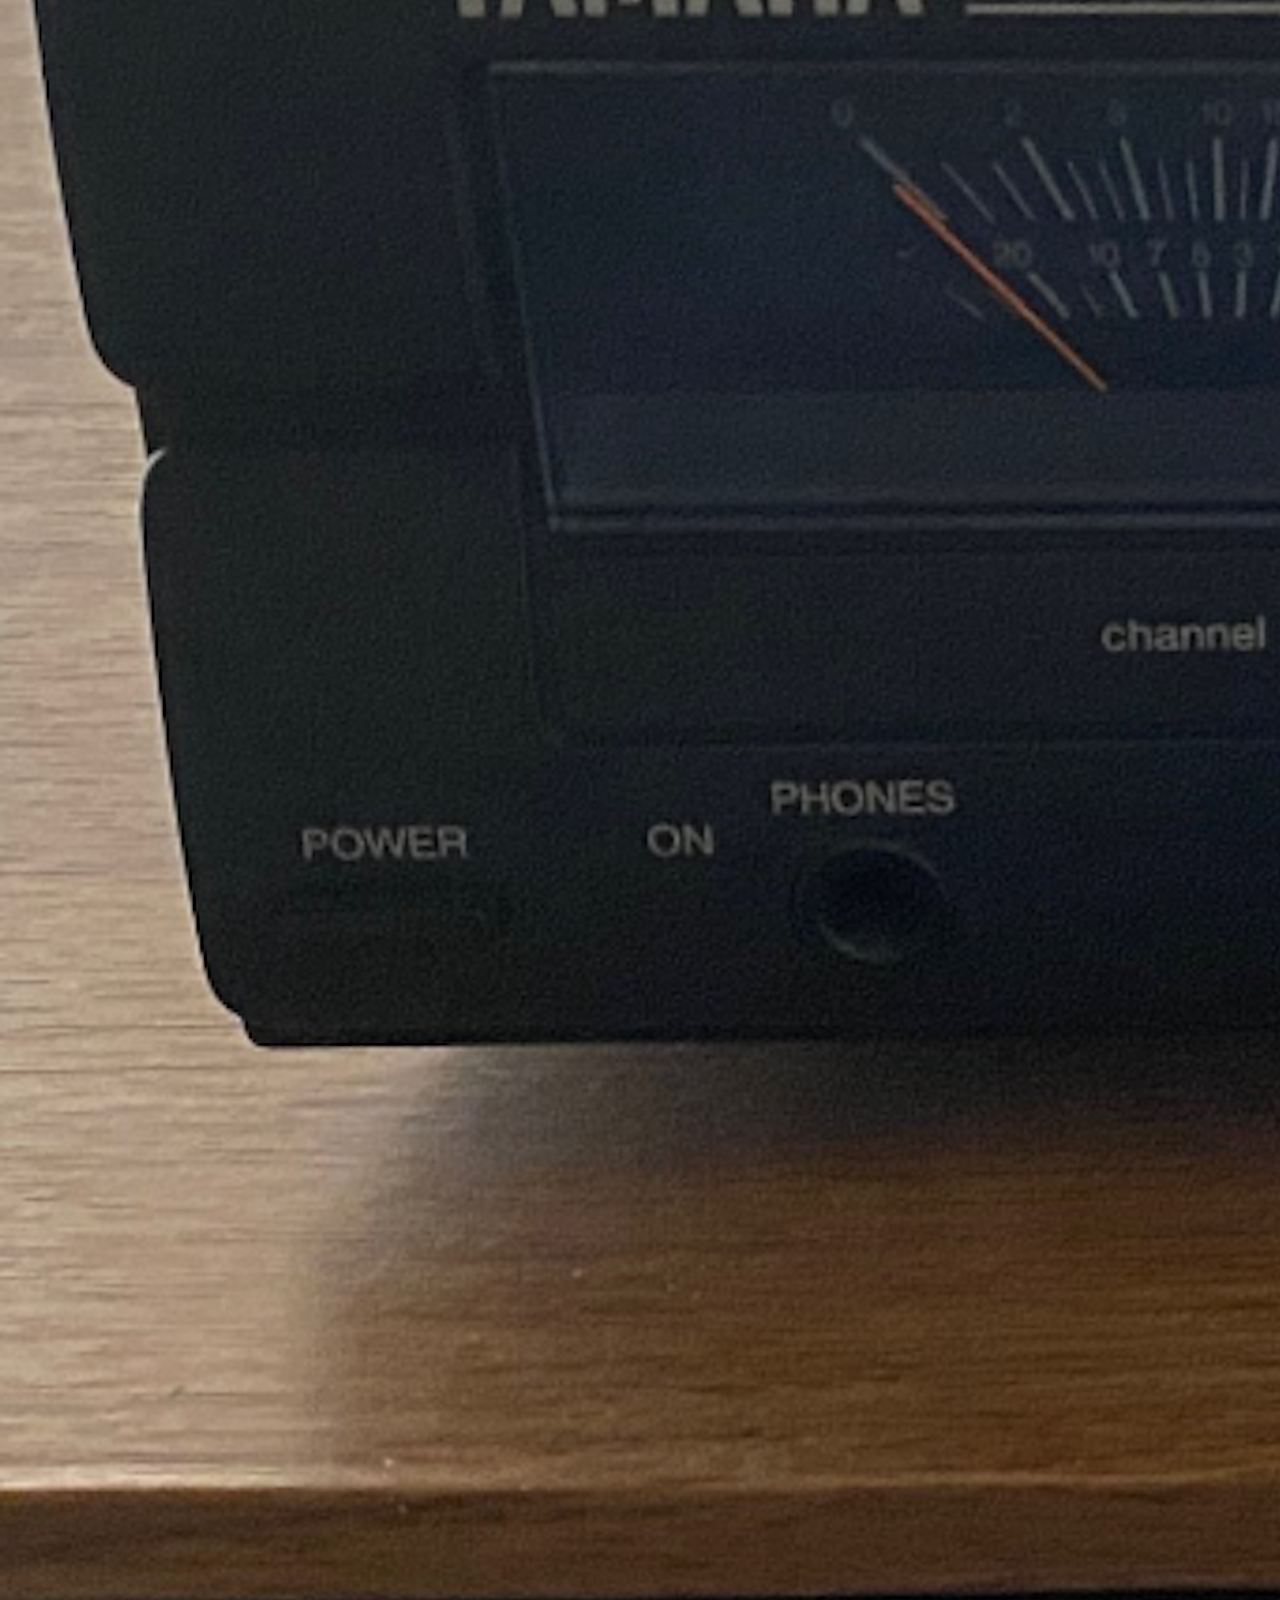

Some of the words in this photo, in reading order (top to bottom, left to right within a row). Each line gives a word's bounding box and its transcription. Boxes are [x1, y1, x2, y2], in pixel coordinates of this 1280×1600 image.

[1201, 98, 1234, 126] 10
[994, 242, 1033, 268] 20
[1090, 242, 1121, 268] 10
[1149, 242, 1169, 267] 7
[1234, 242, 1253, 267] 3
[1101, 613, 1266, 655] channel
[769, 780, 956, 816] PHONES
[301, 826, 469, 861] POWER
[646, 823, 715, 858] ON
